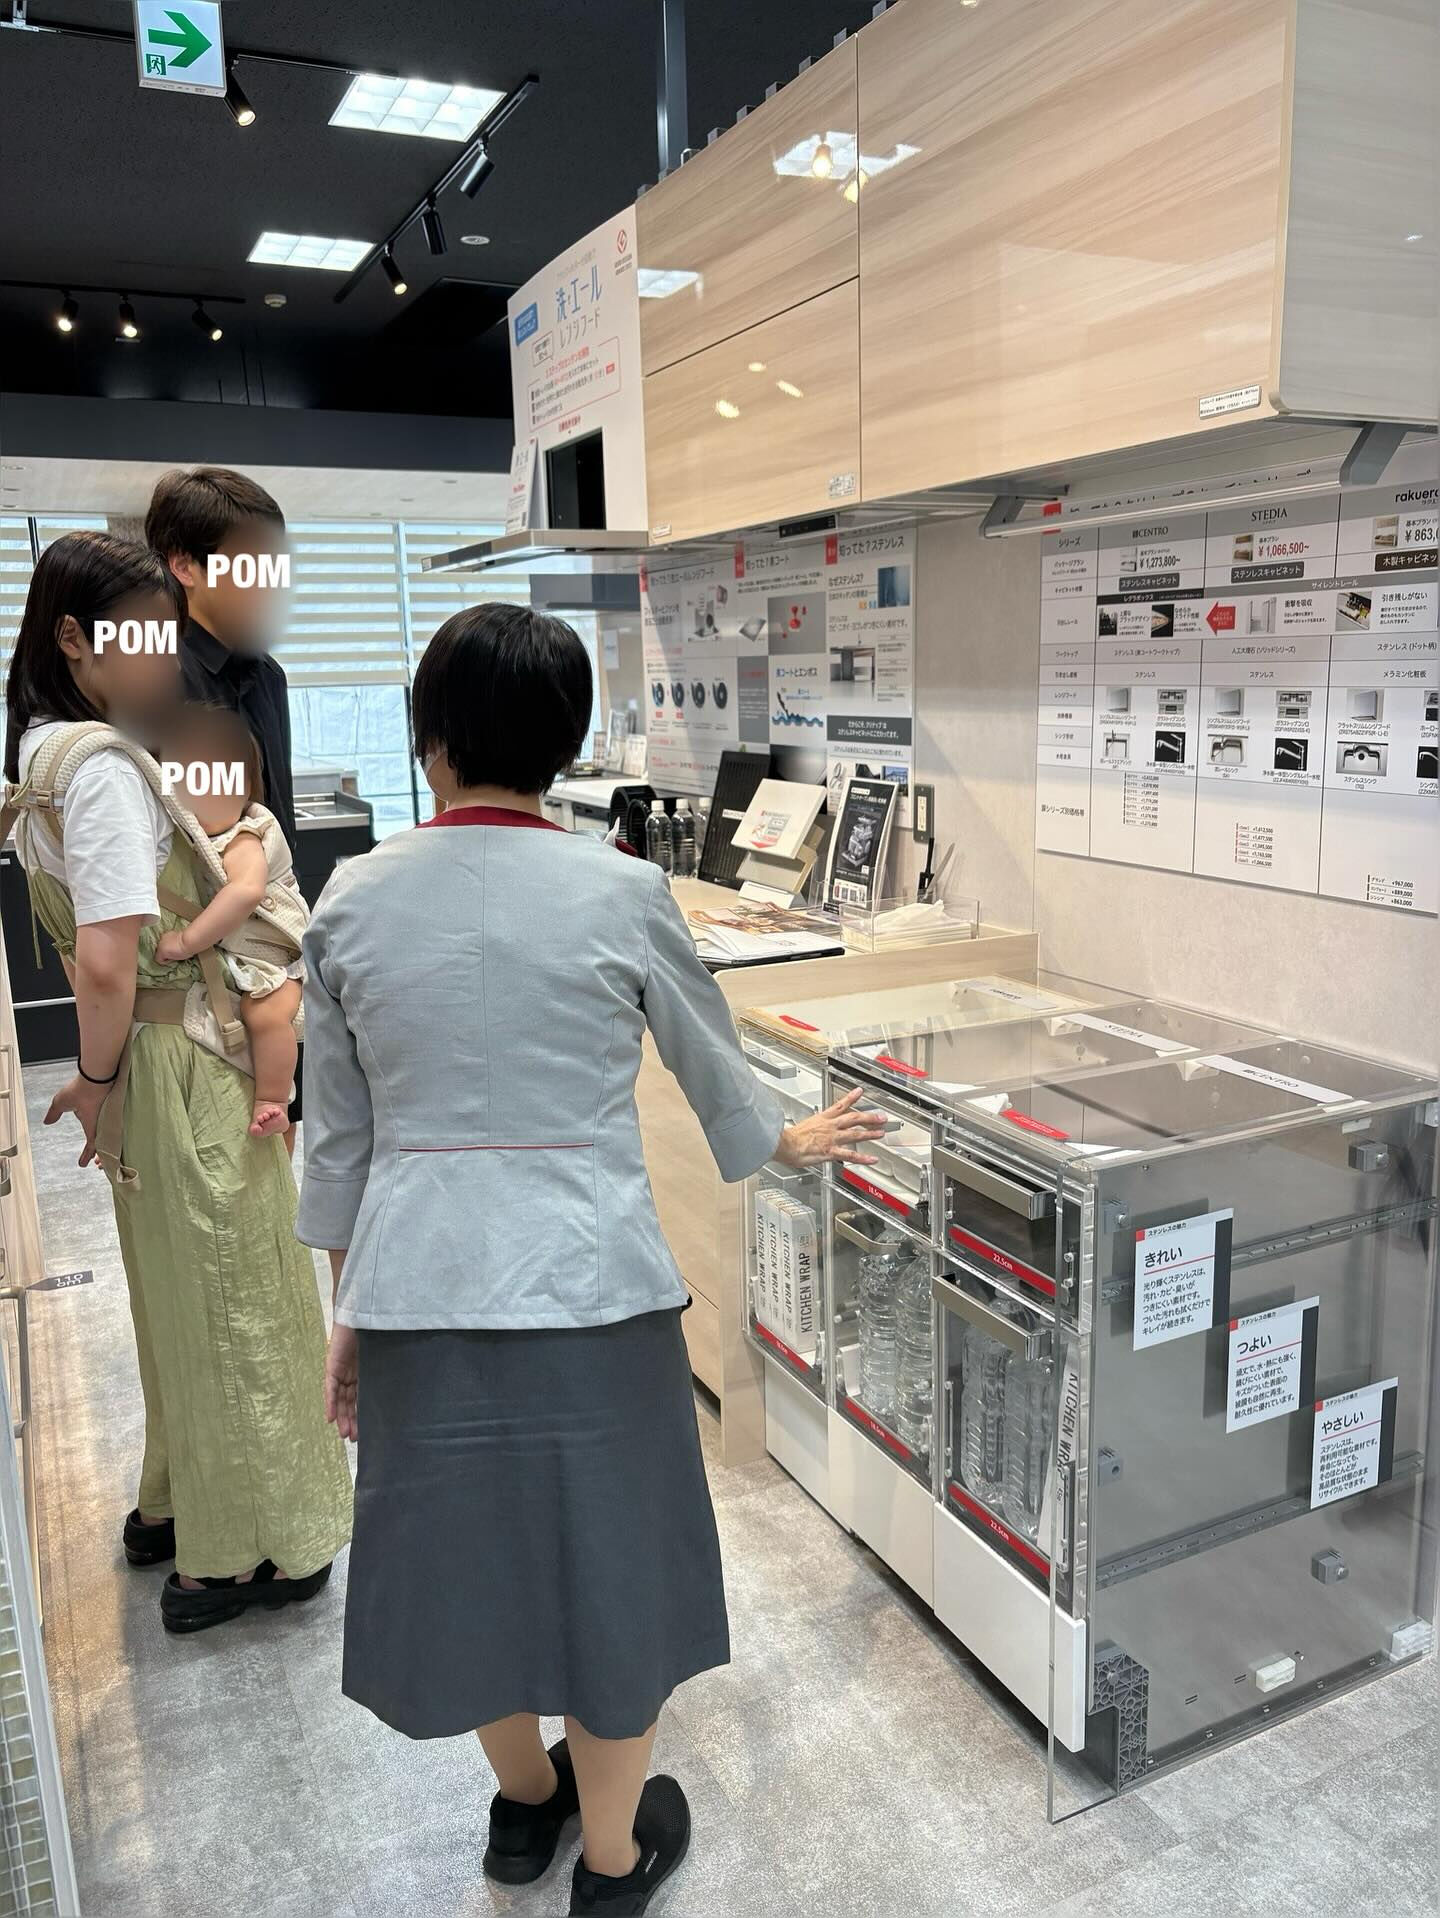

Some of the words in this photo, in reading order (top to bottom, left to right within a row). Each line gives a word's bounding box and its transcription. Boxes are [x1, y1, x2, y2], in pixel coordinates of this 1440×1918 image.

[1251, 508, 1288, 522] STEDIA
[1058, 536, 1081, 548] シリーズ
[1138, 526, 1168, 538] CENTRO
[1249, 671, 1274, 679] ステンレス
[1251, 1070, 1299, 1088] CENTRO
[757, 1213, 765, 1261] KITCHEN
[769, 1222, 778, 1271] KITCHEN
[782, 1232, 791, 1280] KITCHEN
[992, 1254, 1013, 1271] 22.5cm
[1144, 1247, 1183, 1269] きれい
[799, 1253, 811, 1283] WRAP
[771, 1272, 779, 1302] WRAP
[784, 1282, 792, 1313] WRAP
[800, 1284, 812, 1333] KITCHEN
[1143, 1291, 1200, 1313] つきにくい素材です。
[1143, 1299, 1211, 1324] ついた汚れも拭くだけで
[1142, 1316, 1195, 1336] キレイが続きます。
[1236, 1334, 1272, 1355] つよい
[1060, 1373, 1078, 1437] KITCHEN
[1321, 1411, 1364, 1435] やさしい
[1321, 1438, 1354, 1454] ステンレスは、
[990, 1520, 1010, 1541] 22.5cm
